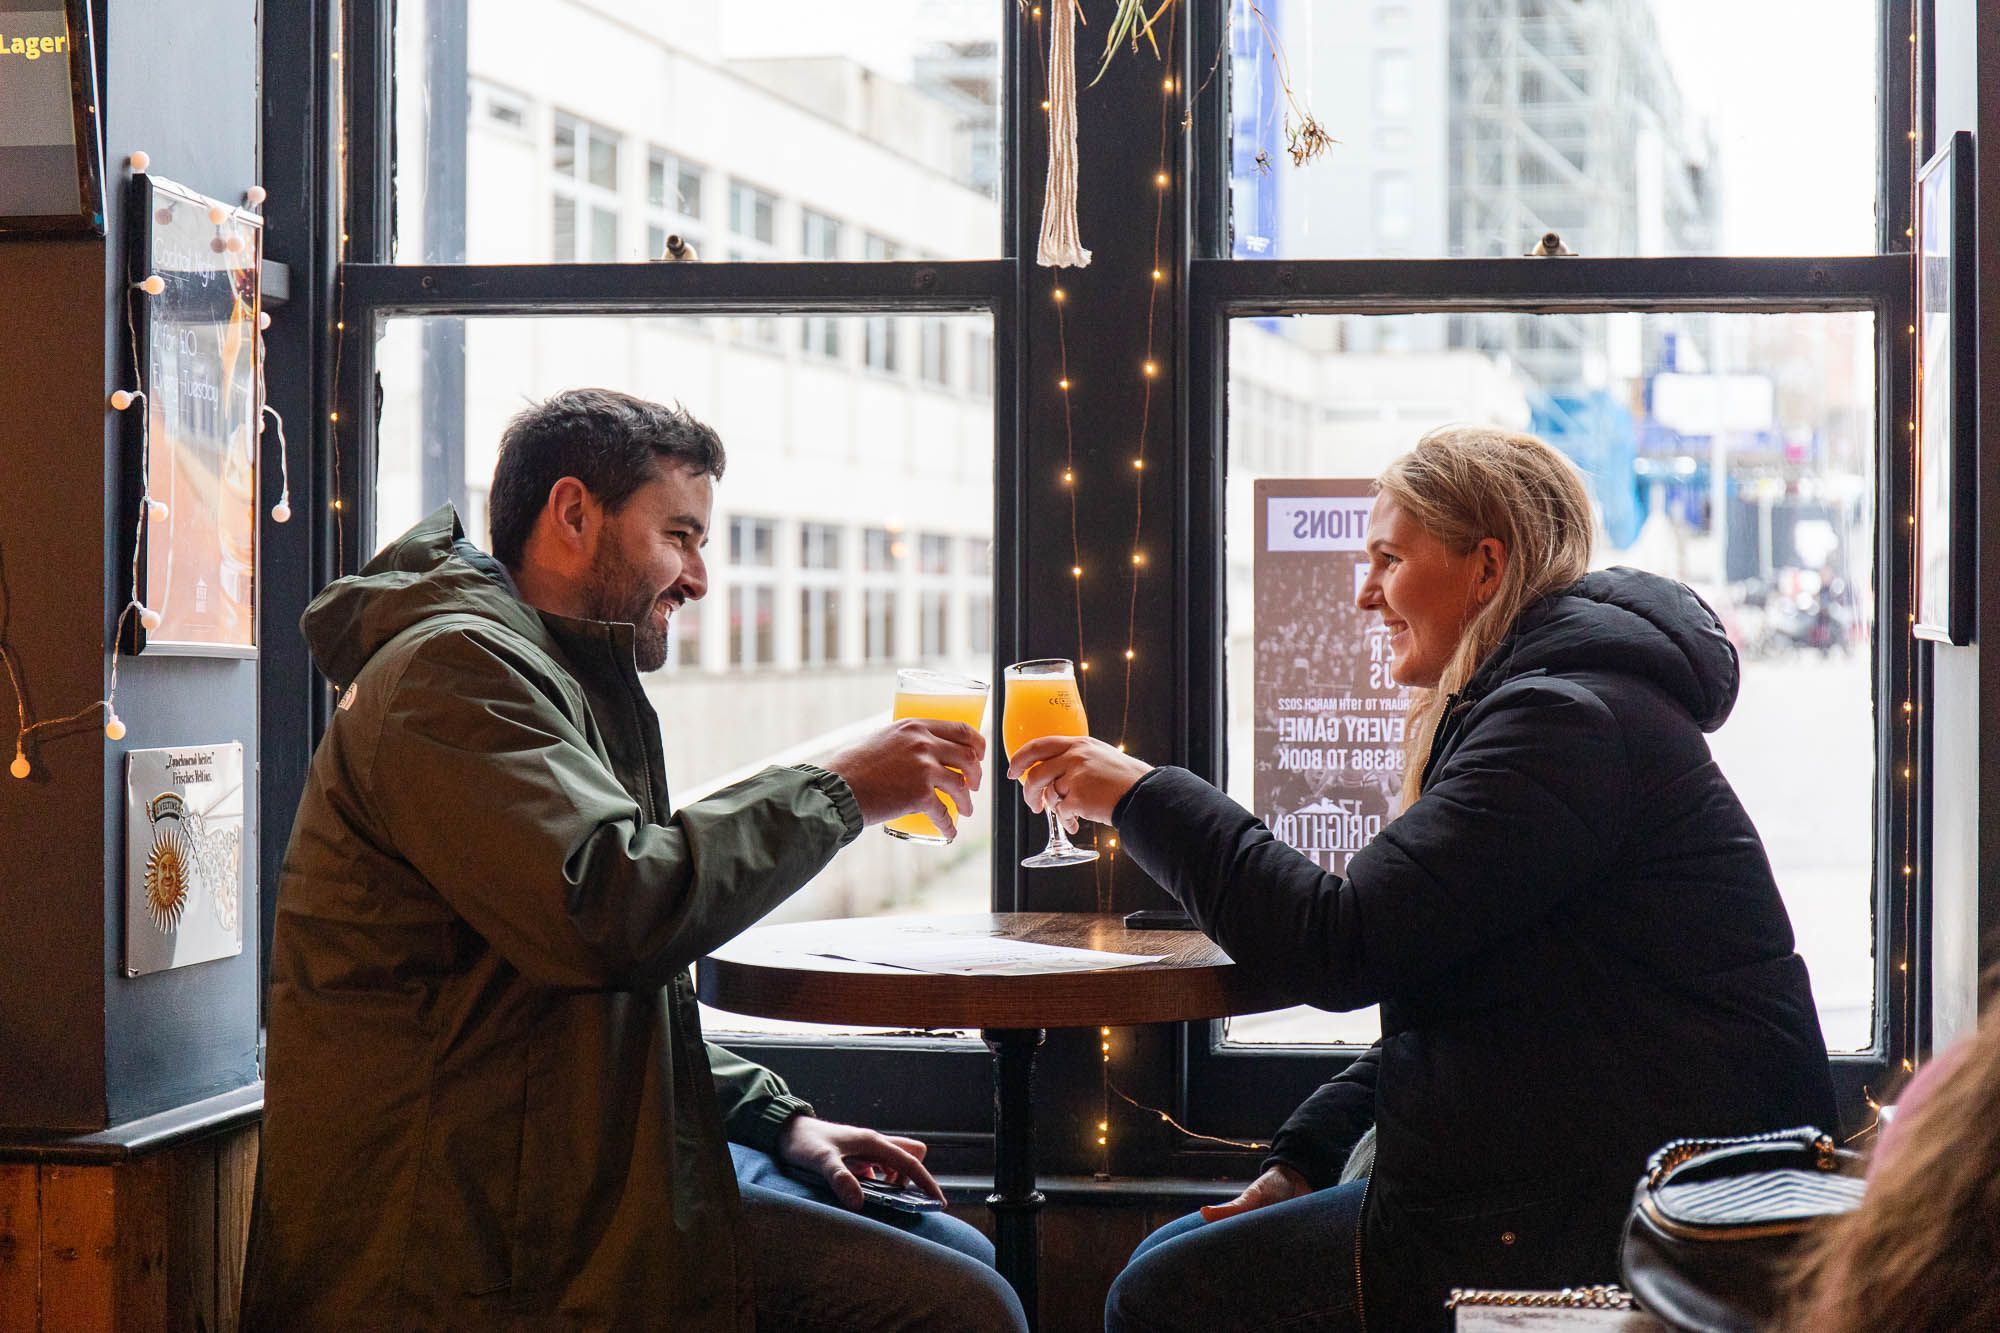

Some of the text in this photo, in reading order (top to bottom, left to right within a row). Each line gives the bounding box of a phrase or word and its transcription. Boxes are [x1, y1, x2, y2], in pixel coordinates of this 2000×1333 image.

[0, 34, 66, 60] Lager
[182, 369, 218, 411] Tuesday
[159, 800, 178, 811] VELTINS
